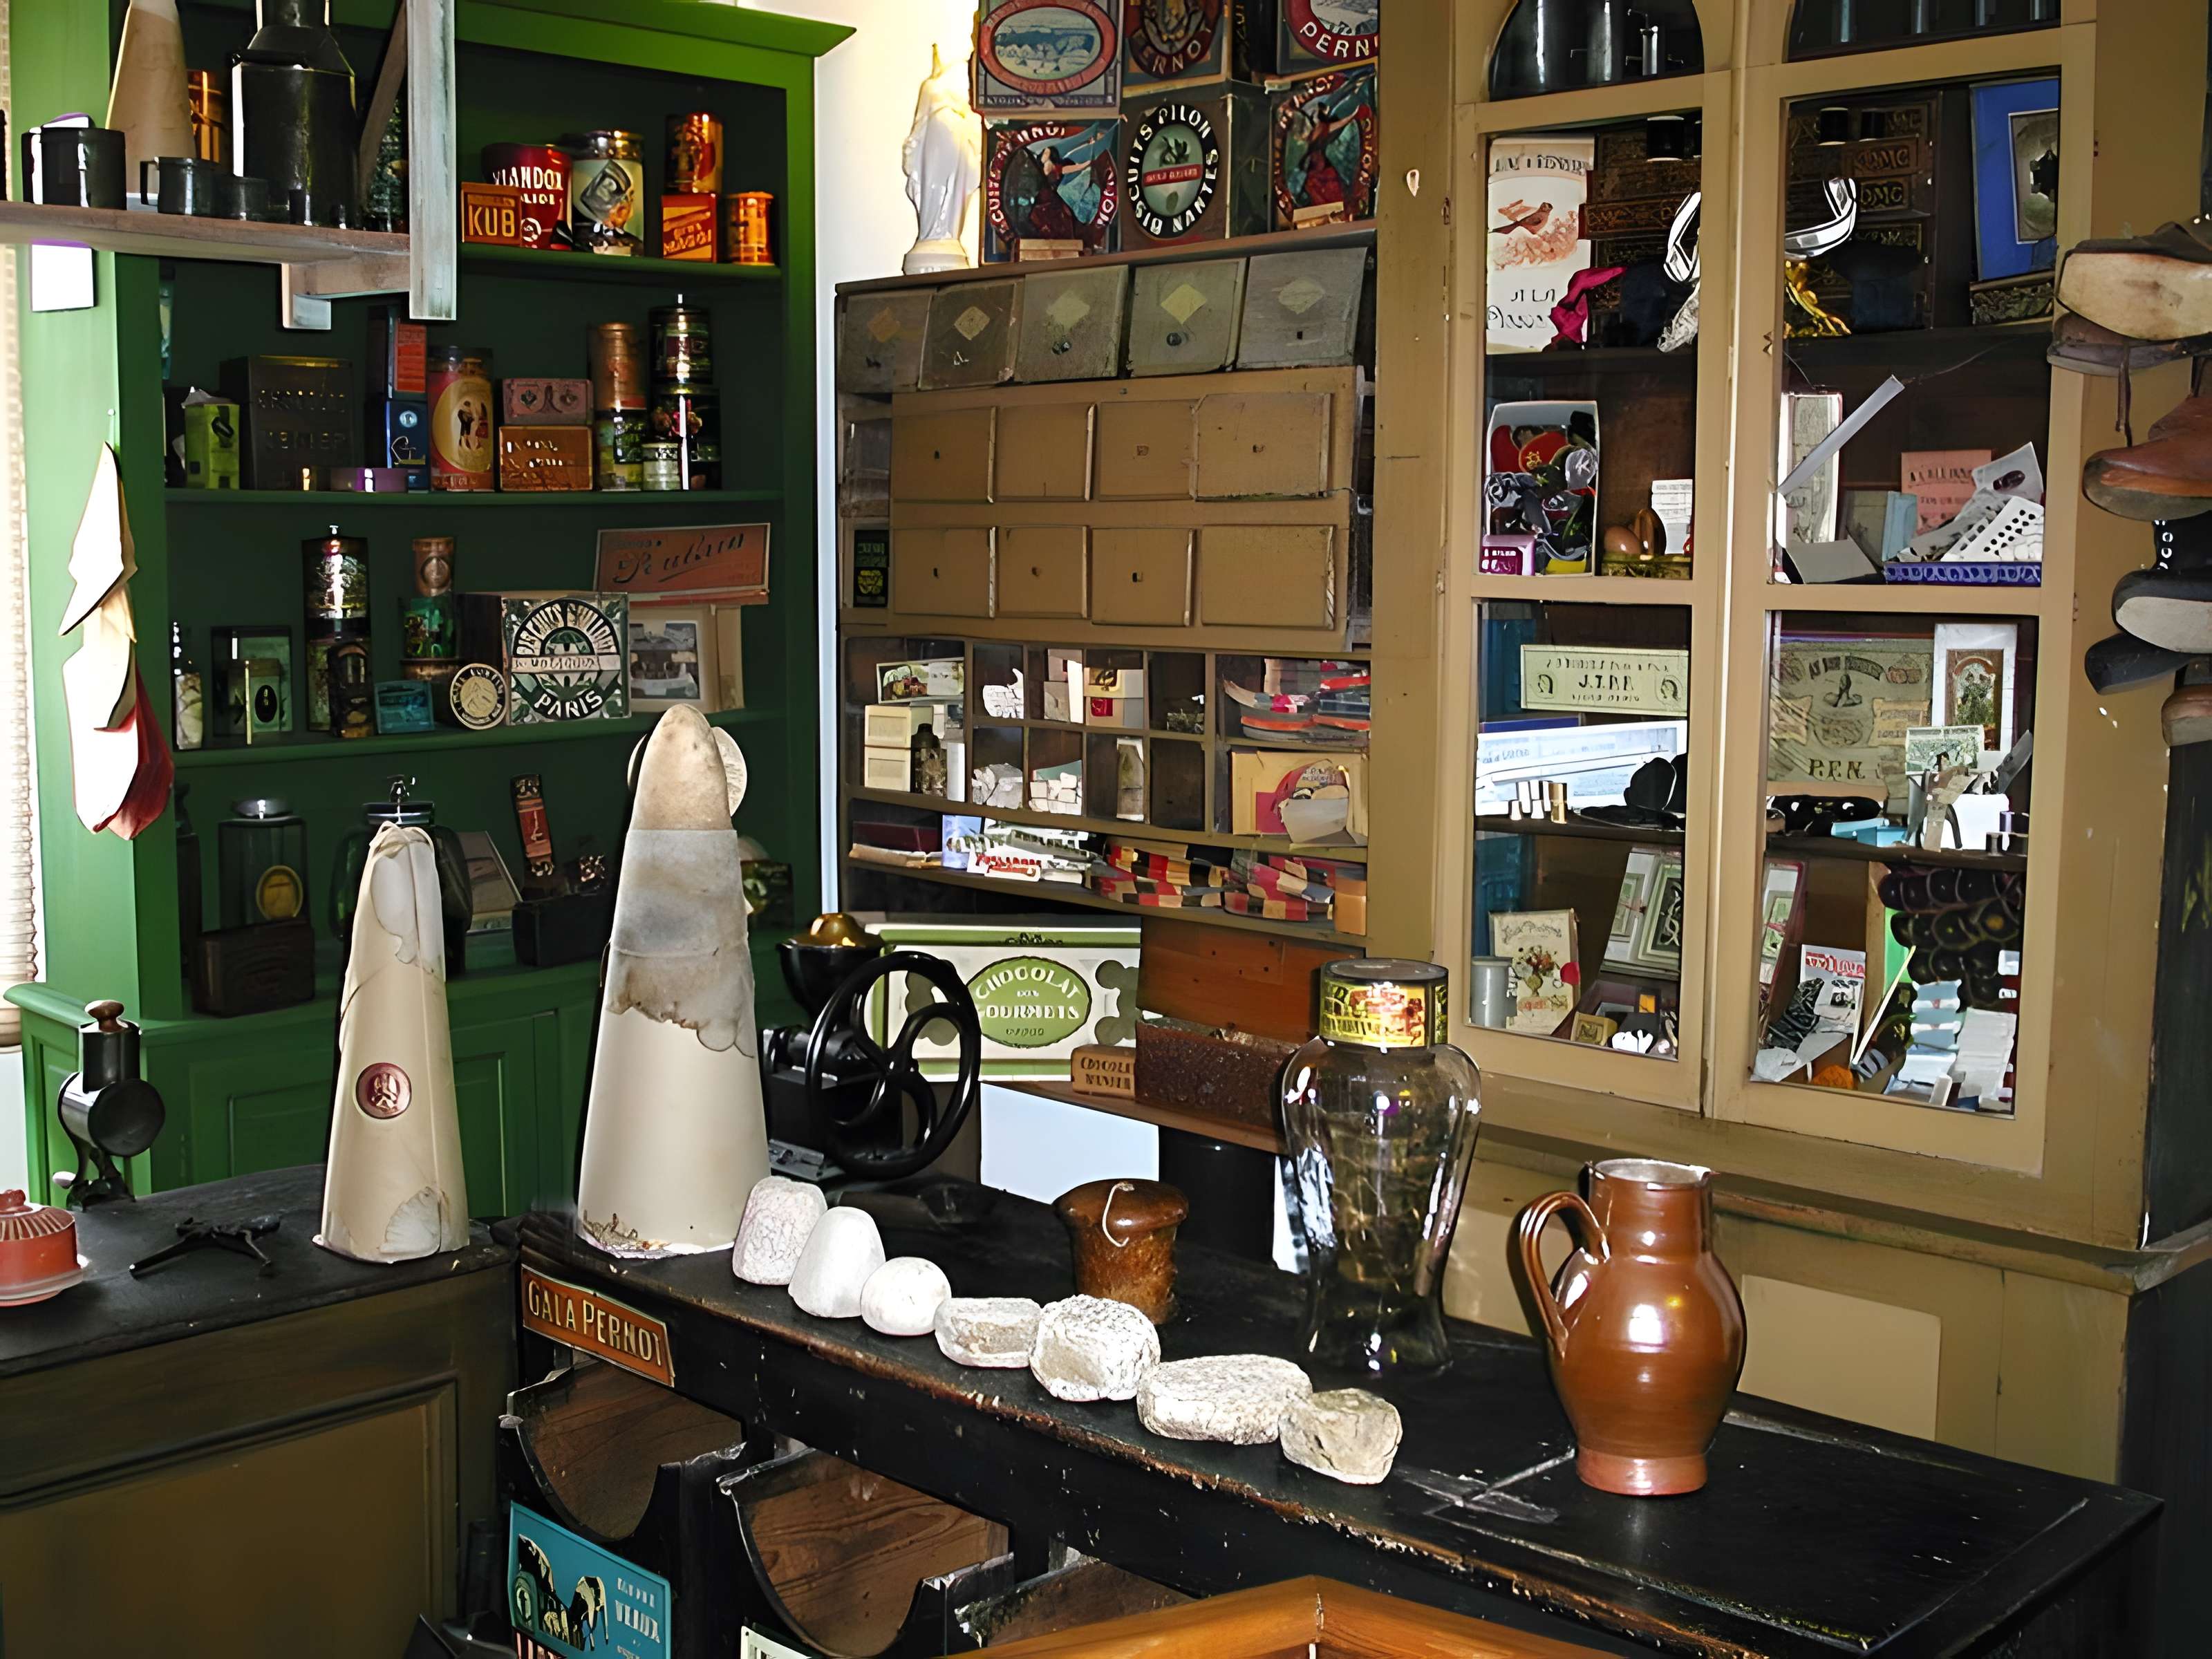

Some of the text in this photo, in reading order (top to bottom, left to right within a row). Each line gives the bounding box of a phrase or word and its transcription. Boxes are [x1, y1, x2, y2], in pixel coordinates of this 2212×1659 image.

[1300, 21, 1378, 57] PERN
[1127, 124, 1163, 235] BISCUITS
[1173, 149, 1219, 233] NANTES
[469, 205, 515, 237] KUB
[534, 690, 603, 718] PARIS
[975, 966, 1081, 1000] CHOCOLAT
